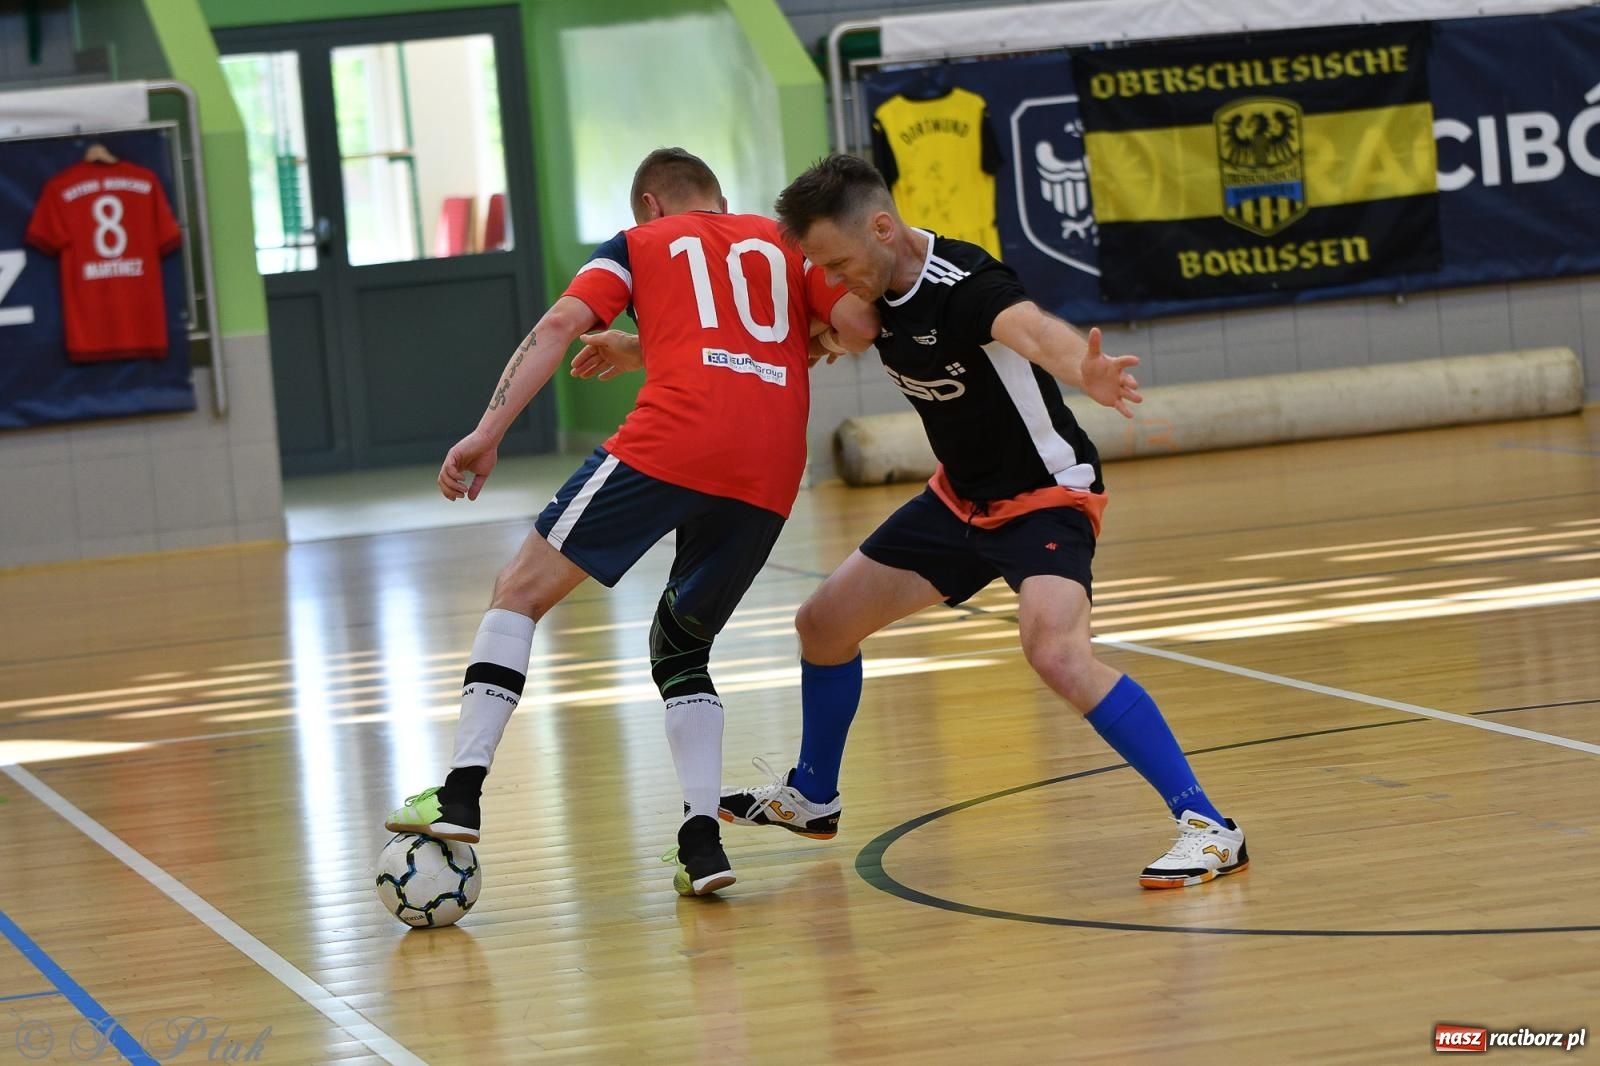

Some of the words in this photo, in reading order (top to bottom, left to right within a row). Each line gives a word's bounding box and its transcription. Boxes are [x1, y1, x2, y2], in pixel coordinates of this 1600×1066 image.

[1090, 45, 1408, 99] OBERSCHLESISCHE
[900, 116, 970, 146] DORTMUND
[92, 194, 127, 259] 8
[1178, 236, 1370, 278] BORUSSEN
[0, 249, 35, 327] Z
[668, 235, 789, 344] 10
